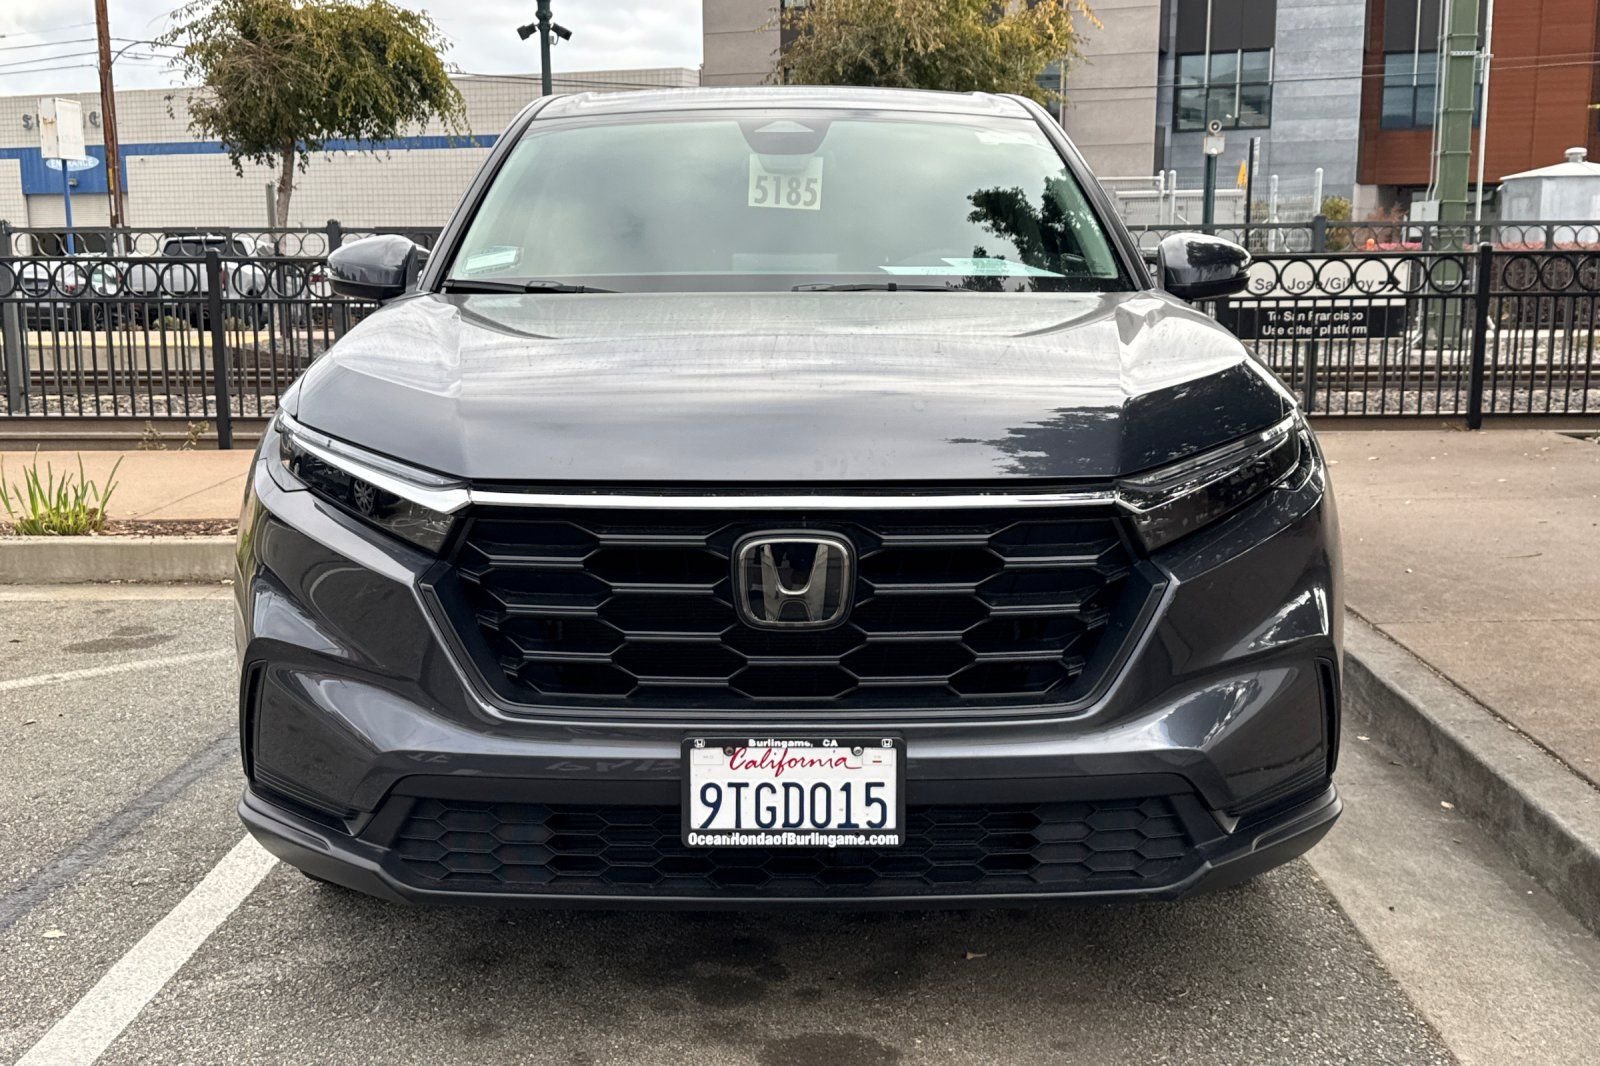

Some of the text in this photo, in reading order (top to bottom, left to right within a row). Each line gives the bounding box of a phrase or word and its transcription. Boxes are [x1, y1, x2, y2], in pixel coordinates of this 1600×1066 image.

[754, 176, 818, 207] 5185
[1267, 311, 1281, 322] To
[1262, 325, 1285, 336] Use
[1287, 324, 1319, 336] othe
[822, 739, 839, 747] CA
[729, 747, 862, 777] California
[699, 782, 888, 829] 9TGD015
[688, 832, 899, 848] OceanHondaofBurlingame.com
